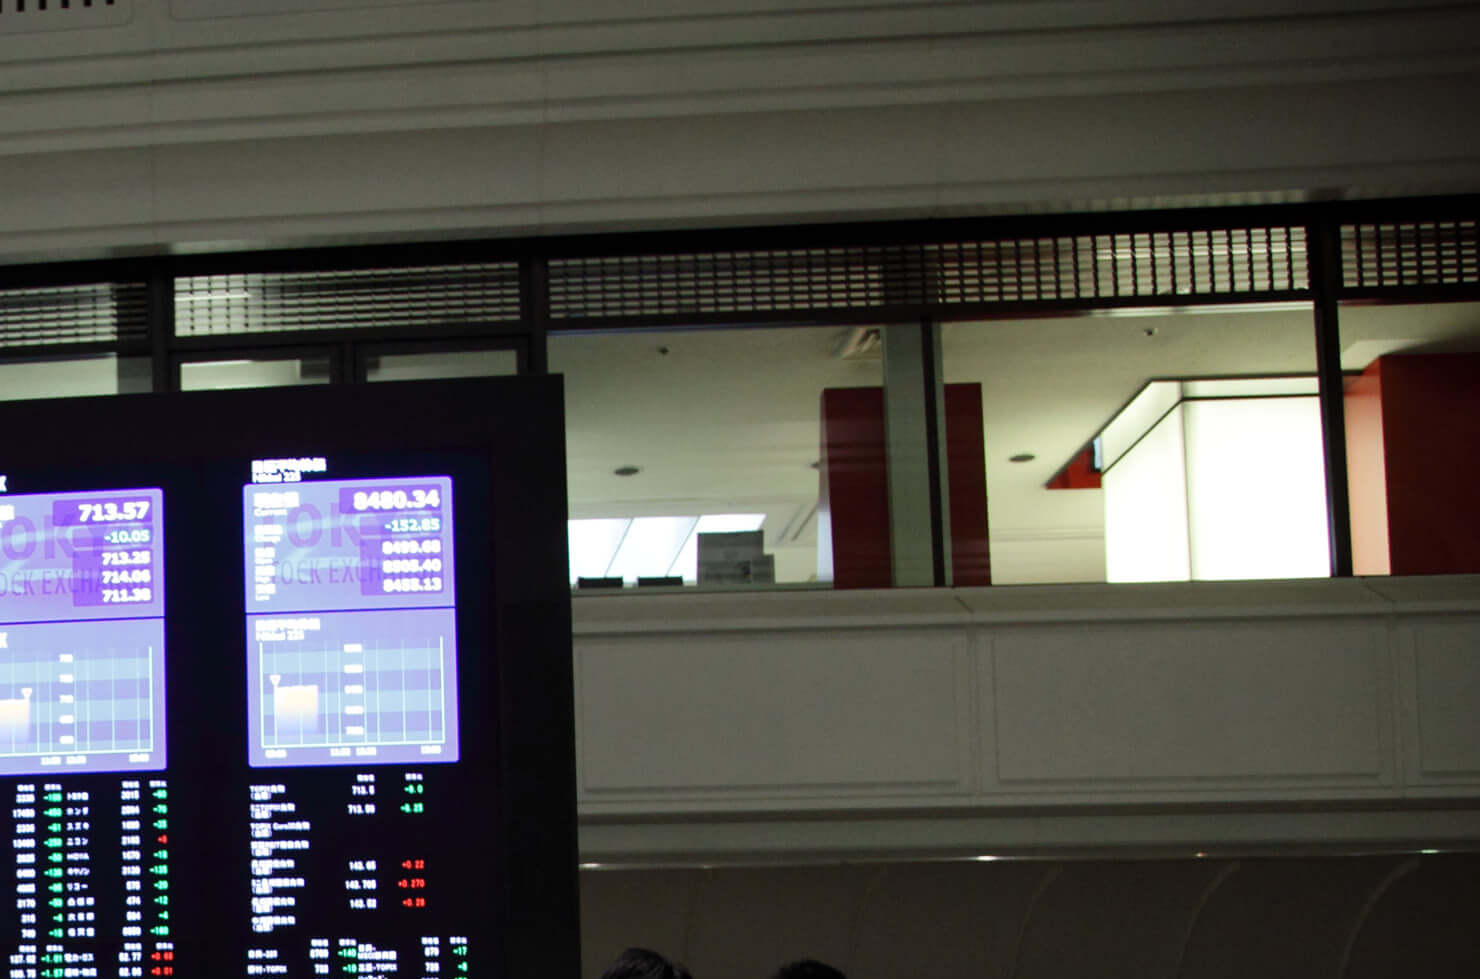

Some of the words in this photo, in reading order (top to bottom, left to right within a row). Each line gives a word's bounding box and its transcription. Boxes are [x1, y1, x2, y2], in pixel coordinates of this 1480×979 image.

[354, 489, 440, 511] 8480.34
[78, 501, 151, 522] 713.57
[104, 529, 150, 544] -10.05
